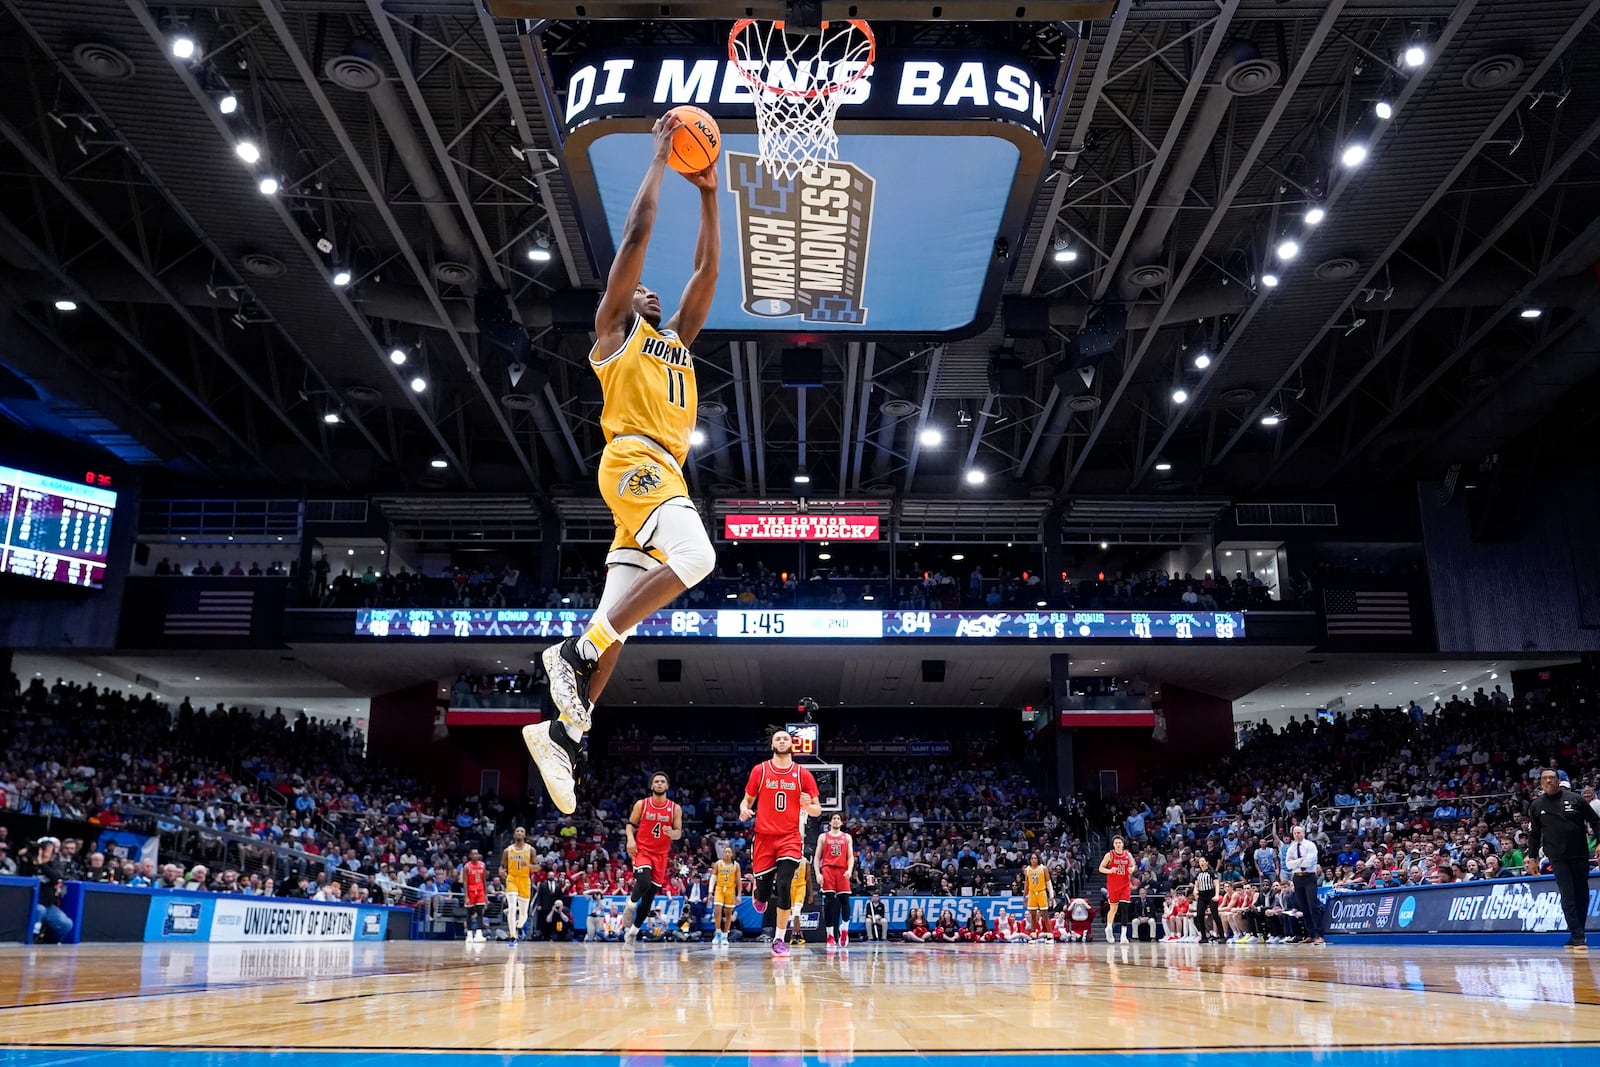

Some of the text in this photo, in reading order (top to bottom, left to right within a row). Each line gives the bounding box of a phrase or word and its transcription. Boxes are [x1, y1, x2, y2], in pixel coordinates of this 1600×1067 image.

[565, 59, 635, 125] DI
[653, 59, 874, 105] MEN'S
[694, 120, 717, 149] NCAA
[799, 161, 851, 292] MADNESS
[749, 215, 796, 300] MARCH
[666, 365, 686, 409] 11
[738, 524, 866, 539] FLIGHT DECK
[758, 517, 847, 526] THE CONNOR
[498, 611, 528, 622] BONUS
[671, 611, 700, 633] 62
[739, 612, 785, 634] 1:45
[828, 618, 849, 629] 2ND
[902, 611, 931, 633] 64
[1074, 613, 1105, 623] BONUS
[540, 620, 550, 637] 7
[1028, 622, 1038, 638] 2
[1134, 622, 1152, 639] 41
[1175, 622, 1193, 639] 31
[1215, 622, 1234, 639] 33
[791, 736, 812, 753] 28
[775, 791, 787, 812] 0
[651, 821, 662, 839] 4
[831, 844, 842, 857] 31
[1331, 899, 1376, 922] Olympians
[1448, 896, 1485, 921] VISIT
[243, 906, 307, 935] UNIVERSITY
[307, 910, 321, 936] OF
[320, 911, 354, 936] DAYTON
